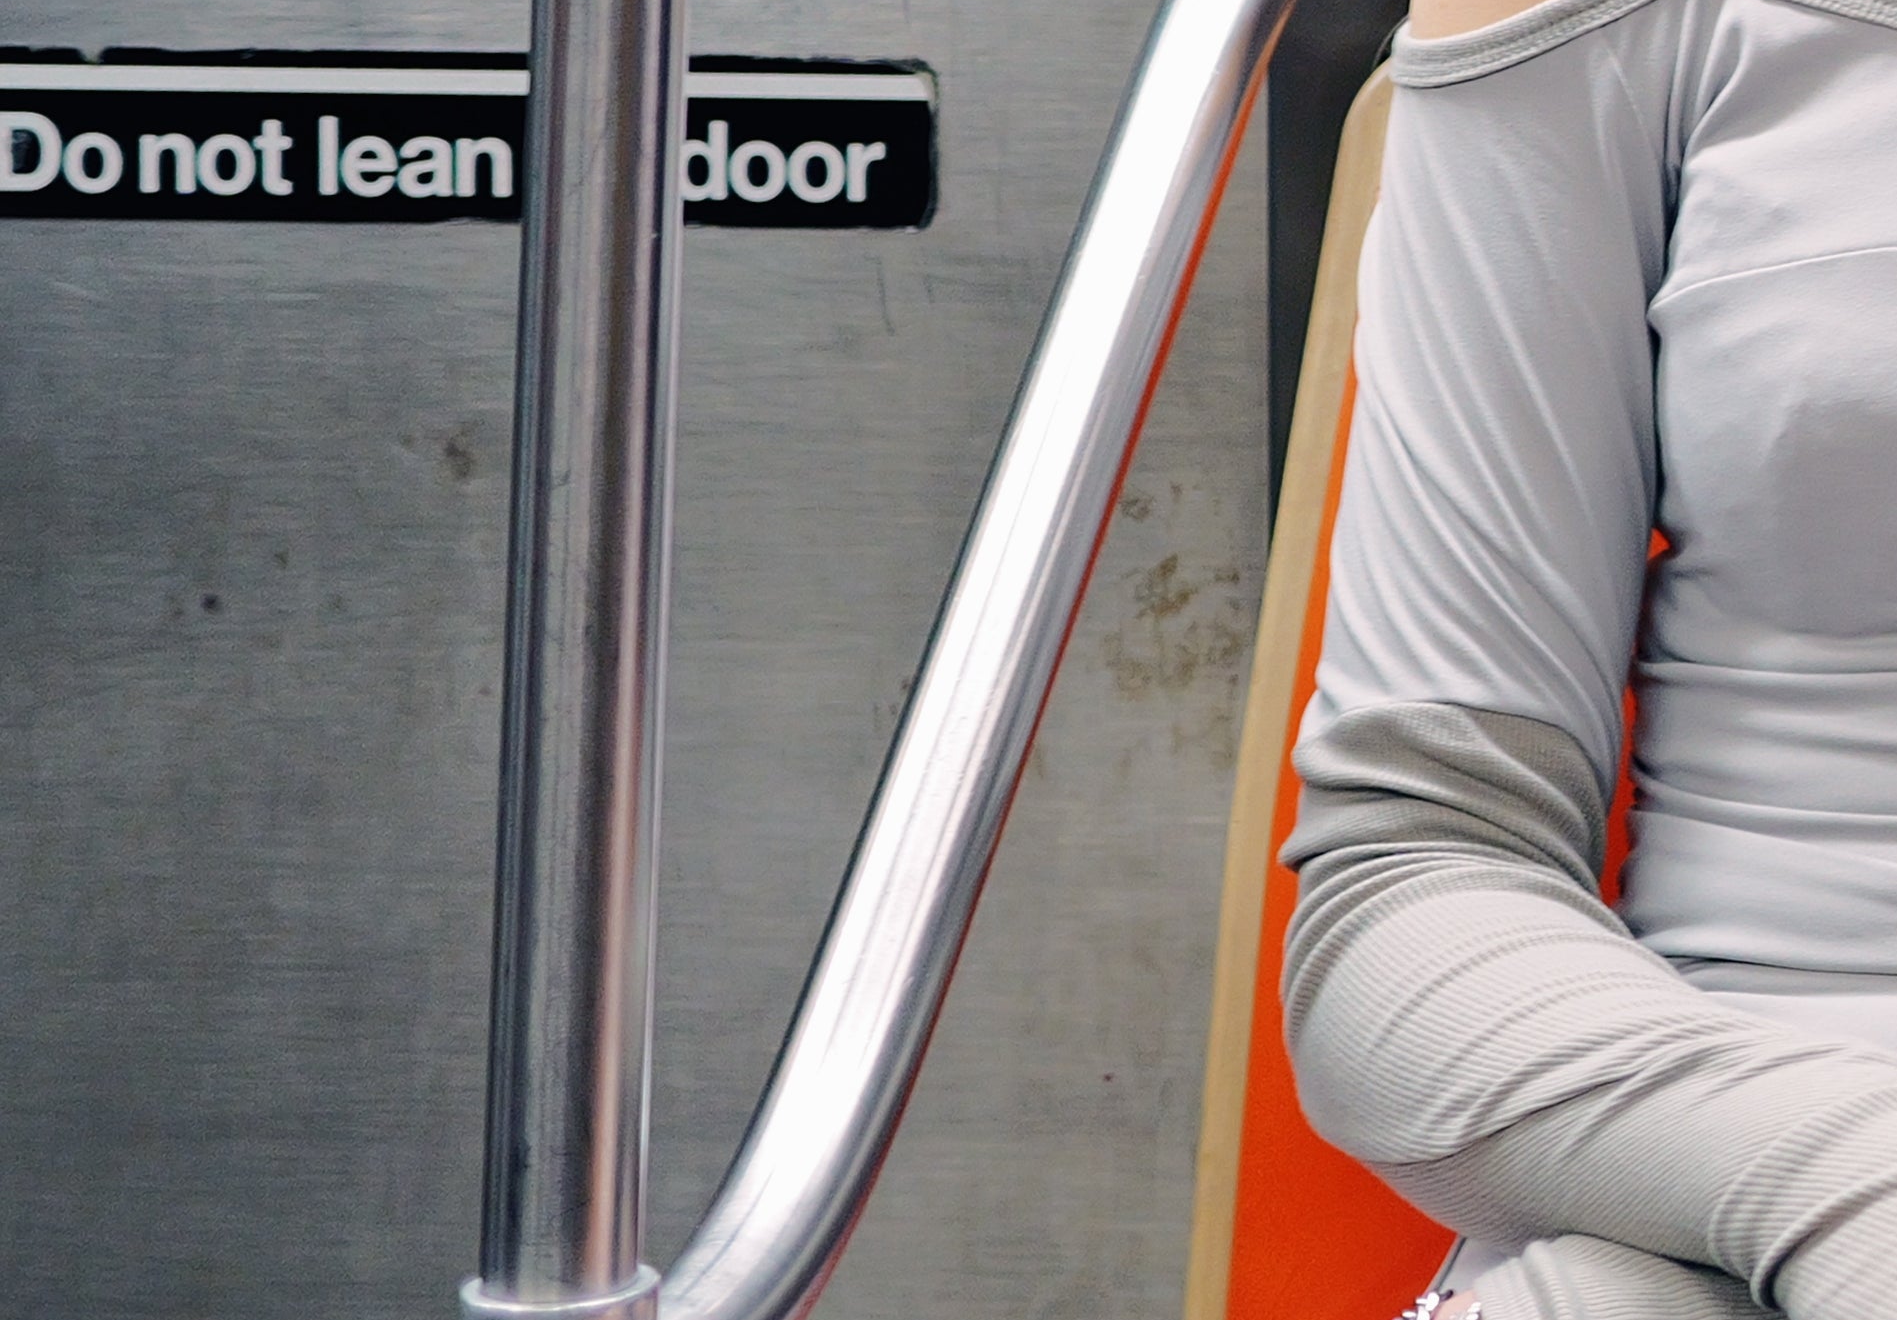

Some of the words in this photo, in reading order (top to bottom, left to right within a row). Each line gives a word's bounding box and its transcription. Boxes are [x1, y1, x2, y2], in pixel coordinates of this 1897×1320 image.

[0, 110, 123, 194] Do
[138, 118, 294, 196] not
[318, 115, 514, 198] lean
[679, 119, 887, 203] door
